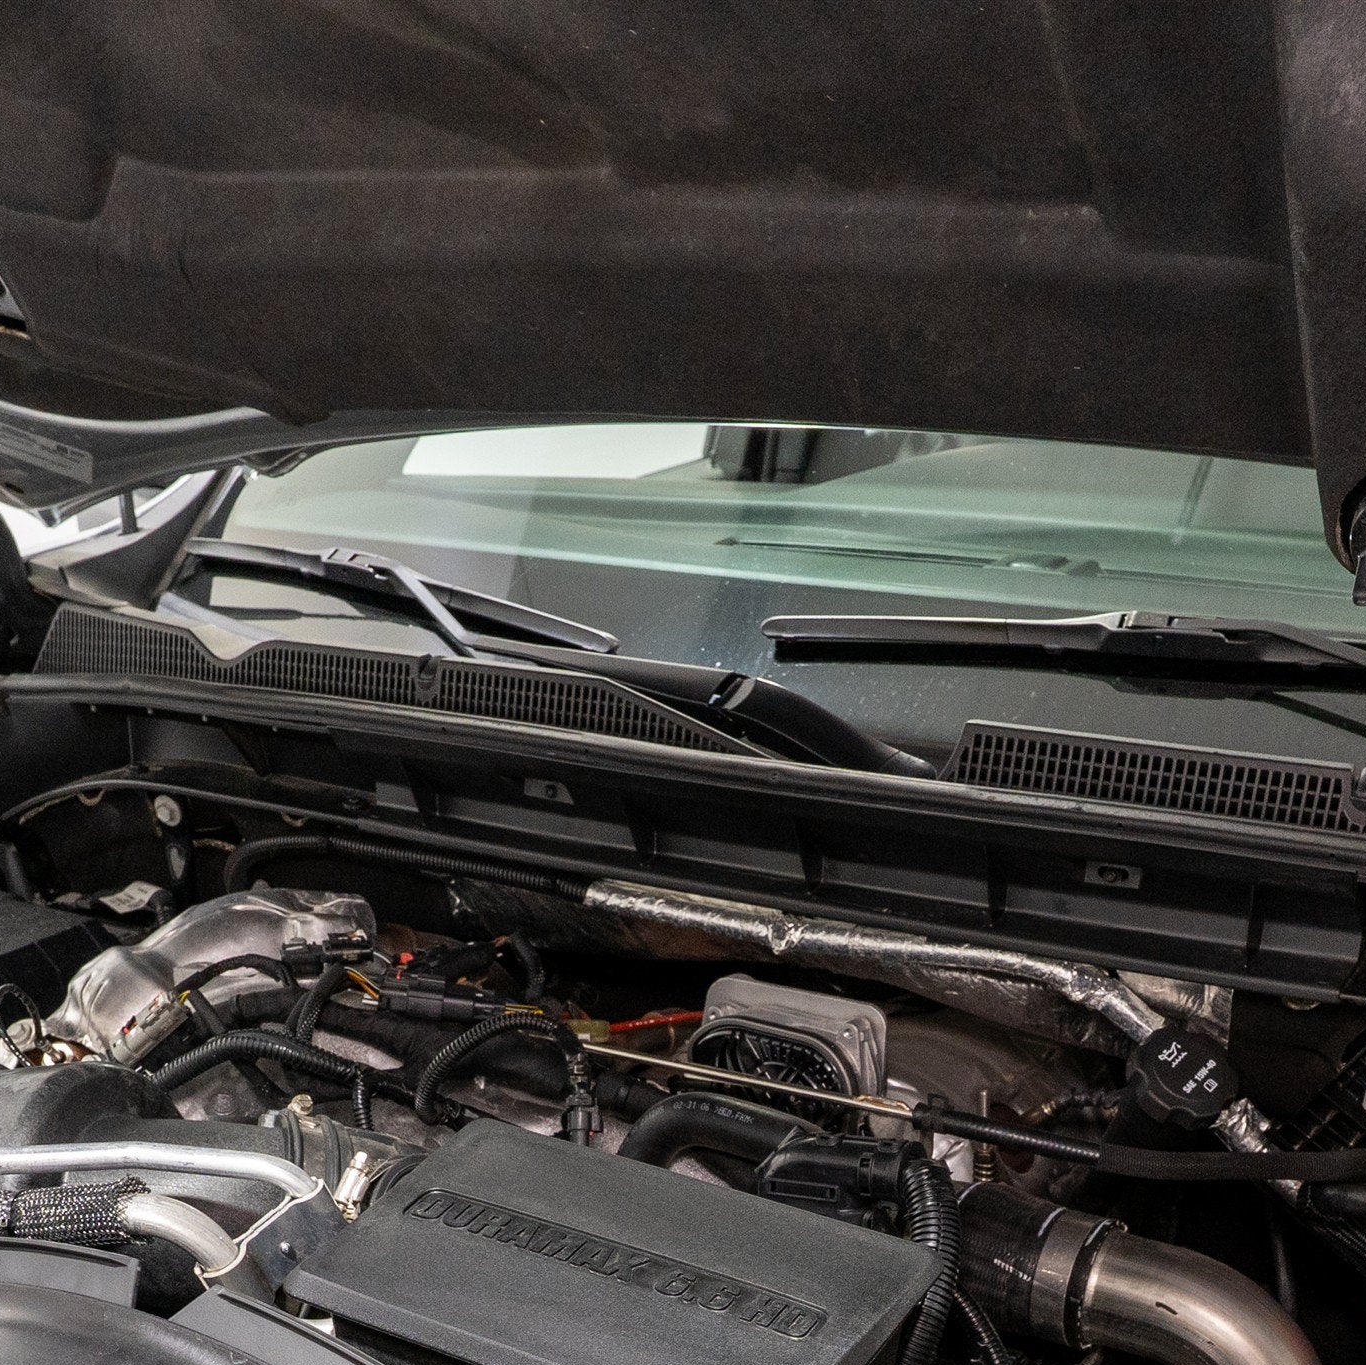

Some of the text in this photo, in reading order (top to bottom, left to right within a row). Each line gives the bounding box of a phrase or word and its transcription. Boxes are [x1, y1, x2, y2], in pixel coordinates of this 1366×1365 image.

[1182, 1059, 1216, 1093] SAE 15W-40
[410, 1197, 821, 1340] DURAMAX 6.6 HD
